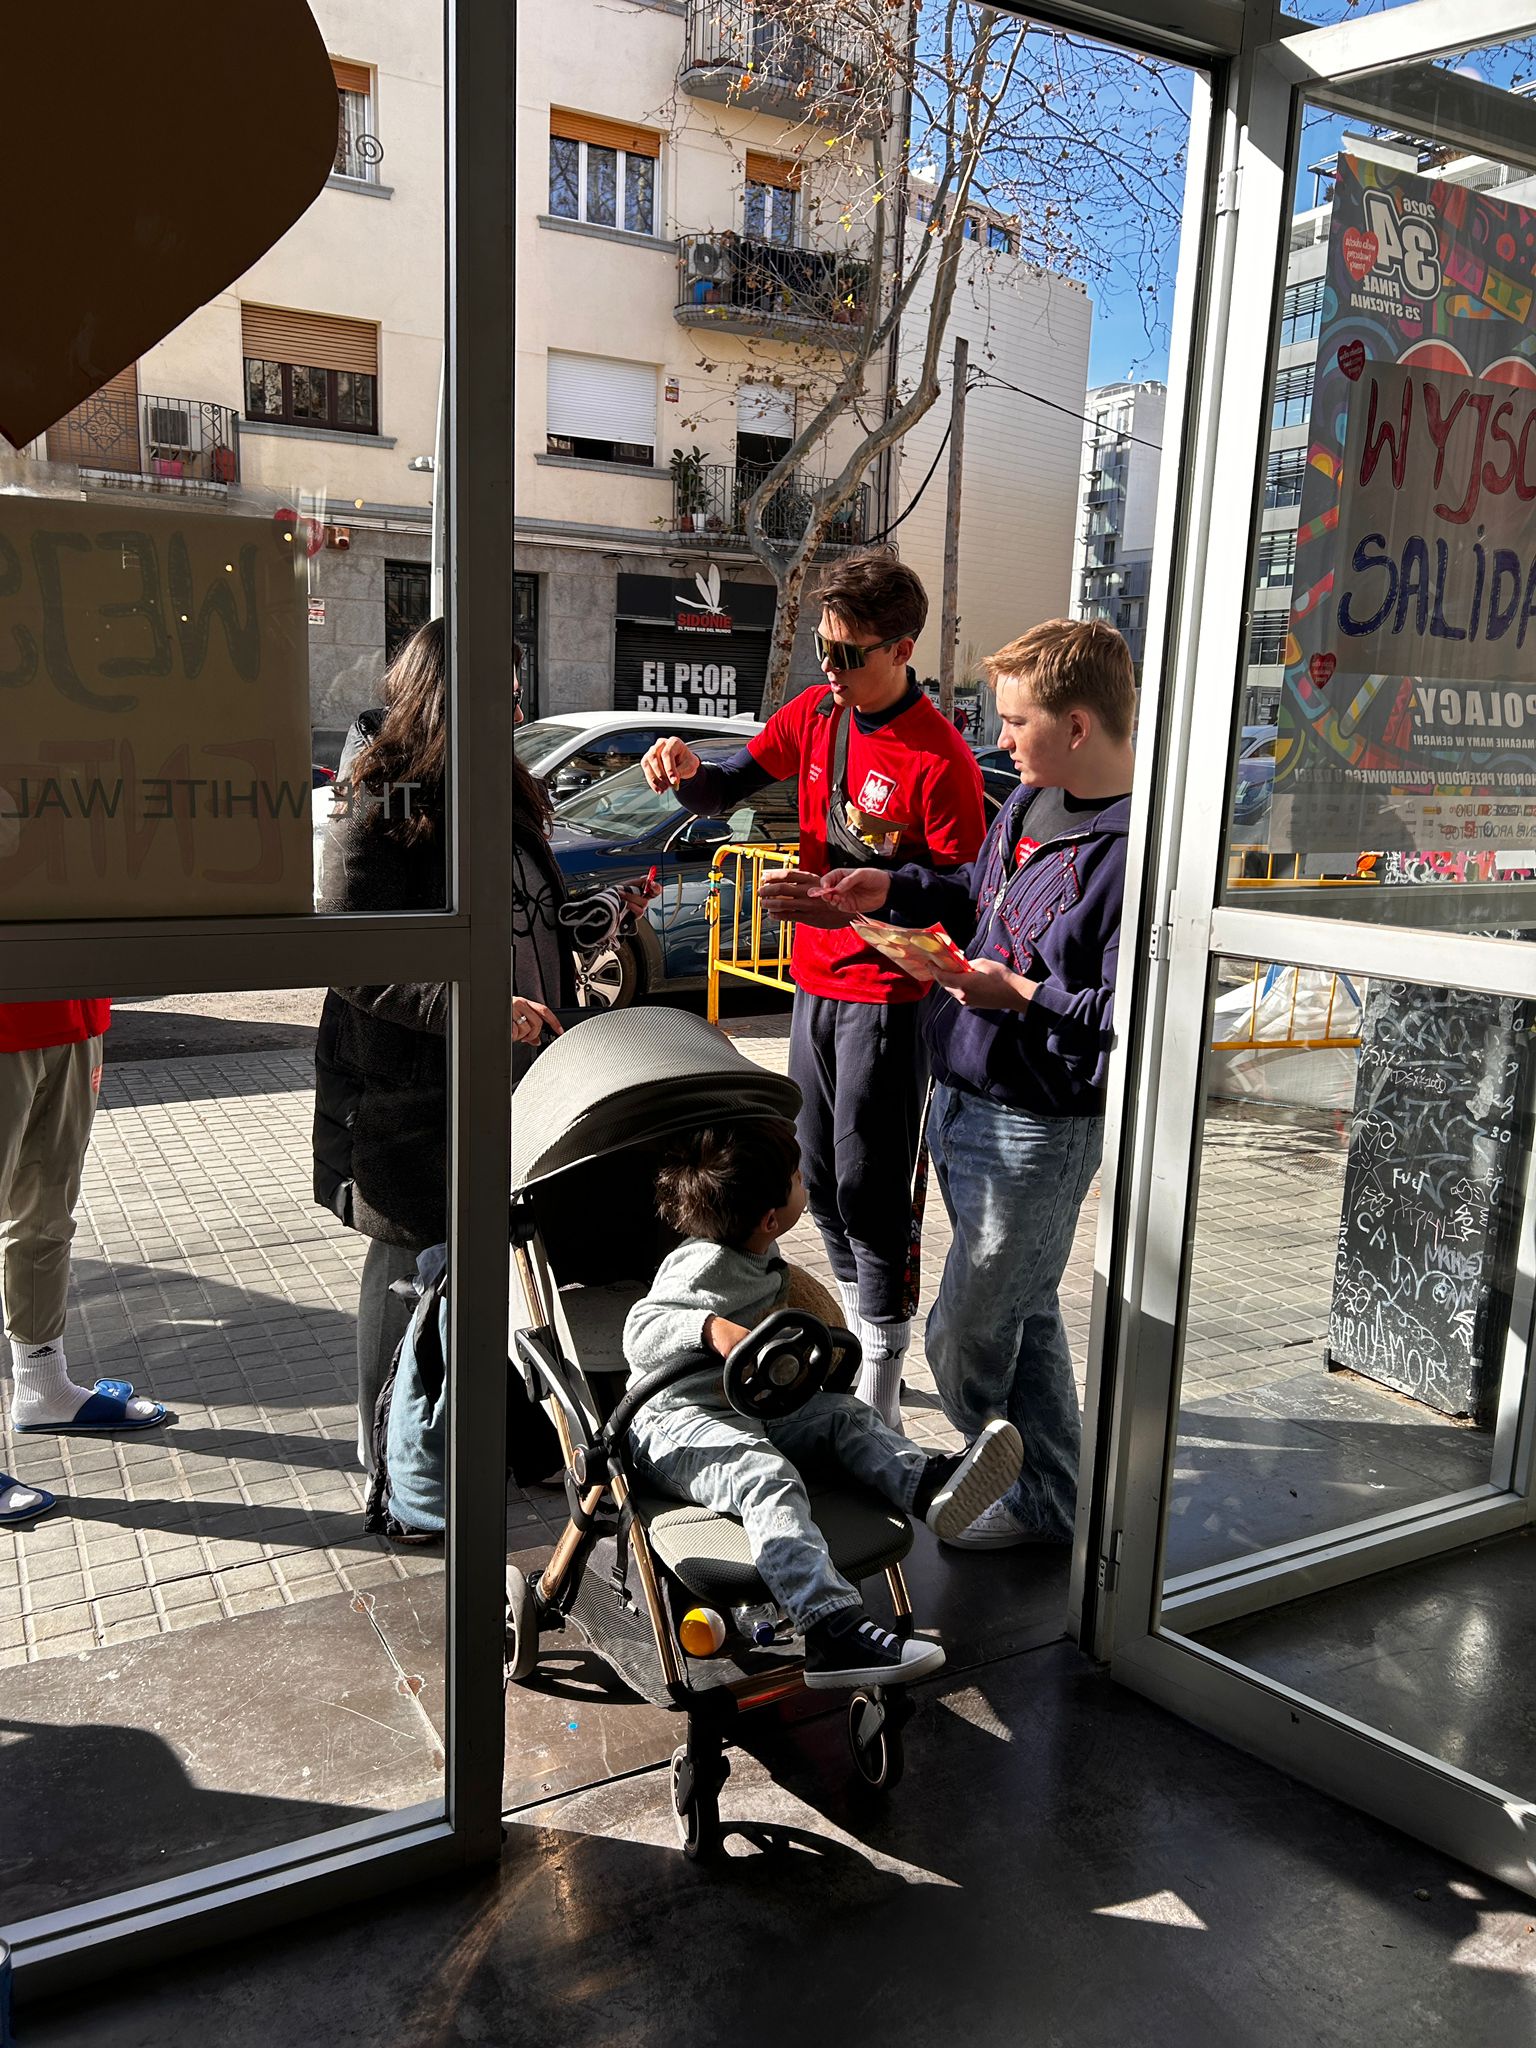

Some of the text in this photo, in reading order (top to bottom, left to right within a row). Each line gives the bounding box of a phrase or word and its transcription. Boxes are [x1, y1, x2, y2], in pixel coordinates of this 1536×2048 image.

[677, 614, 732, 628] SIDONIE
[643, 661, 736, 696] EL PEOR
